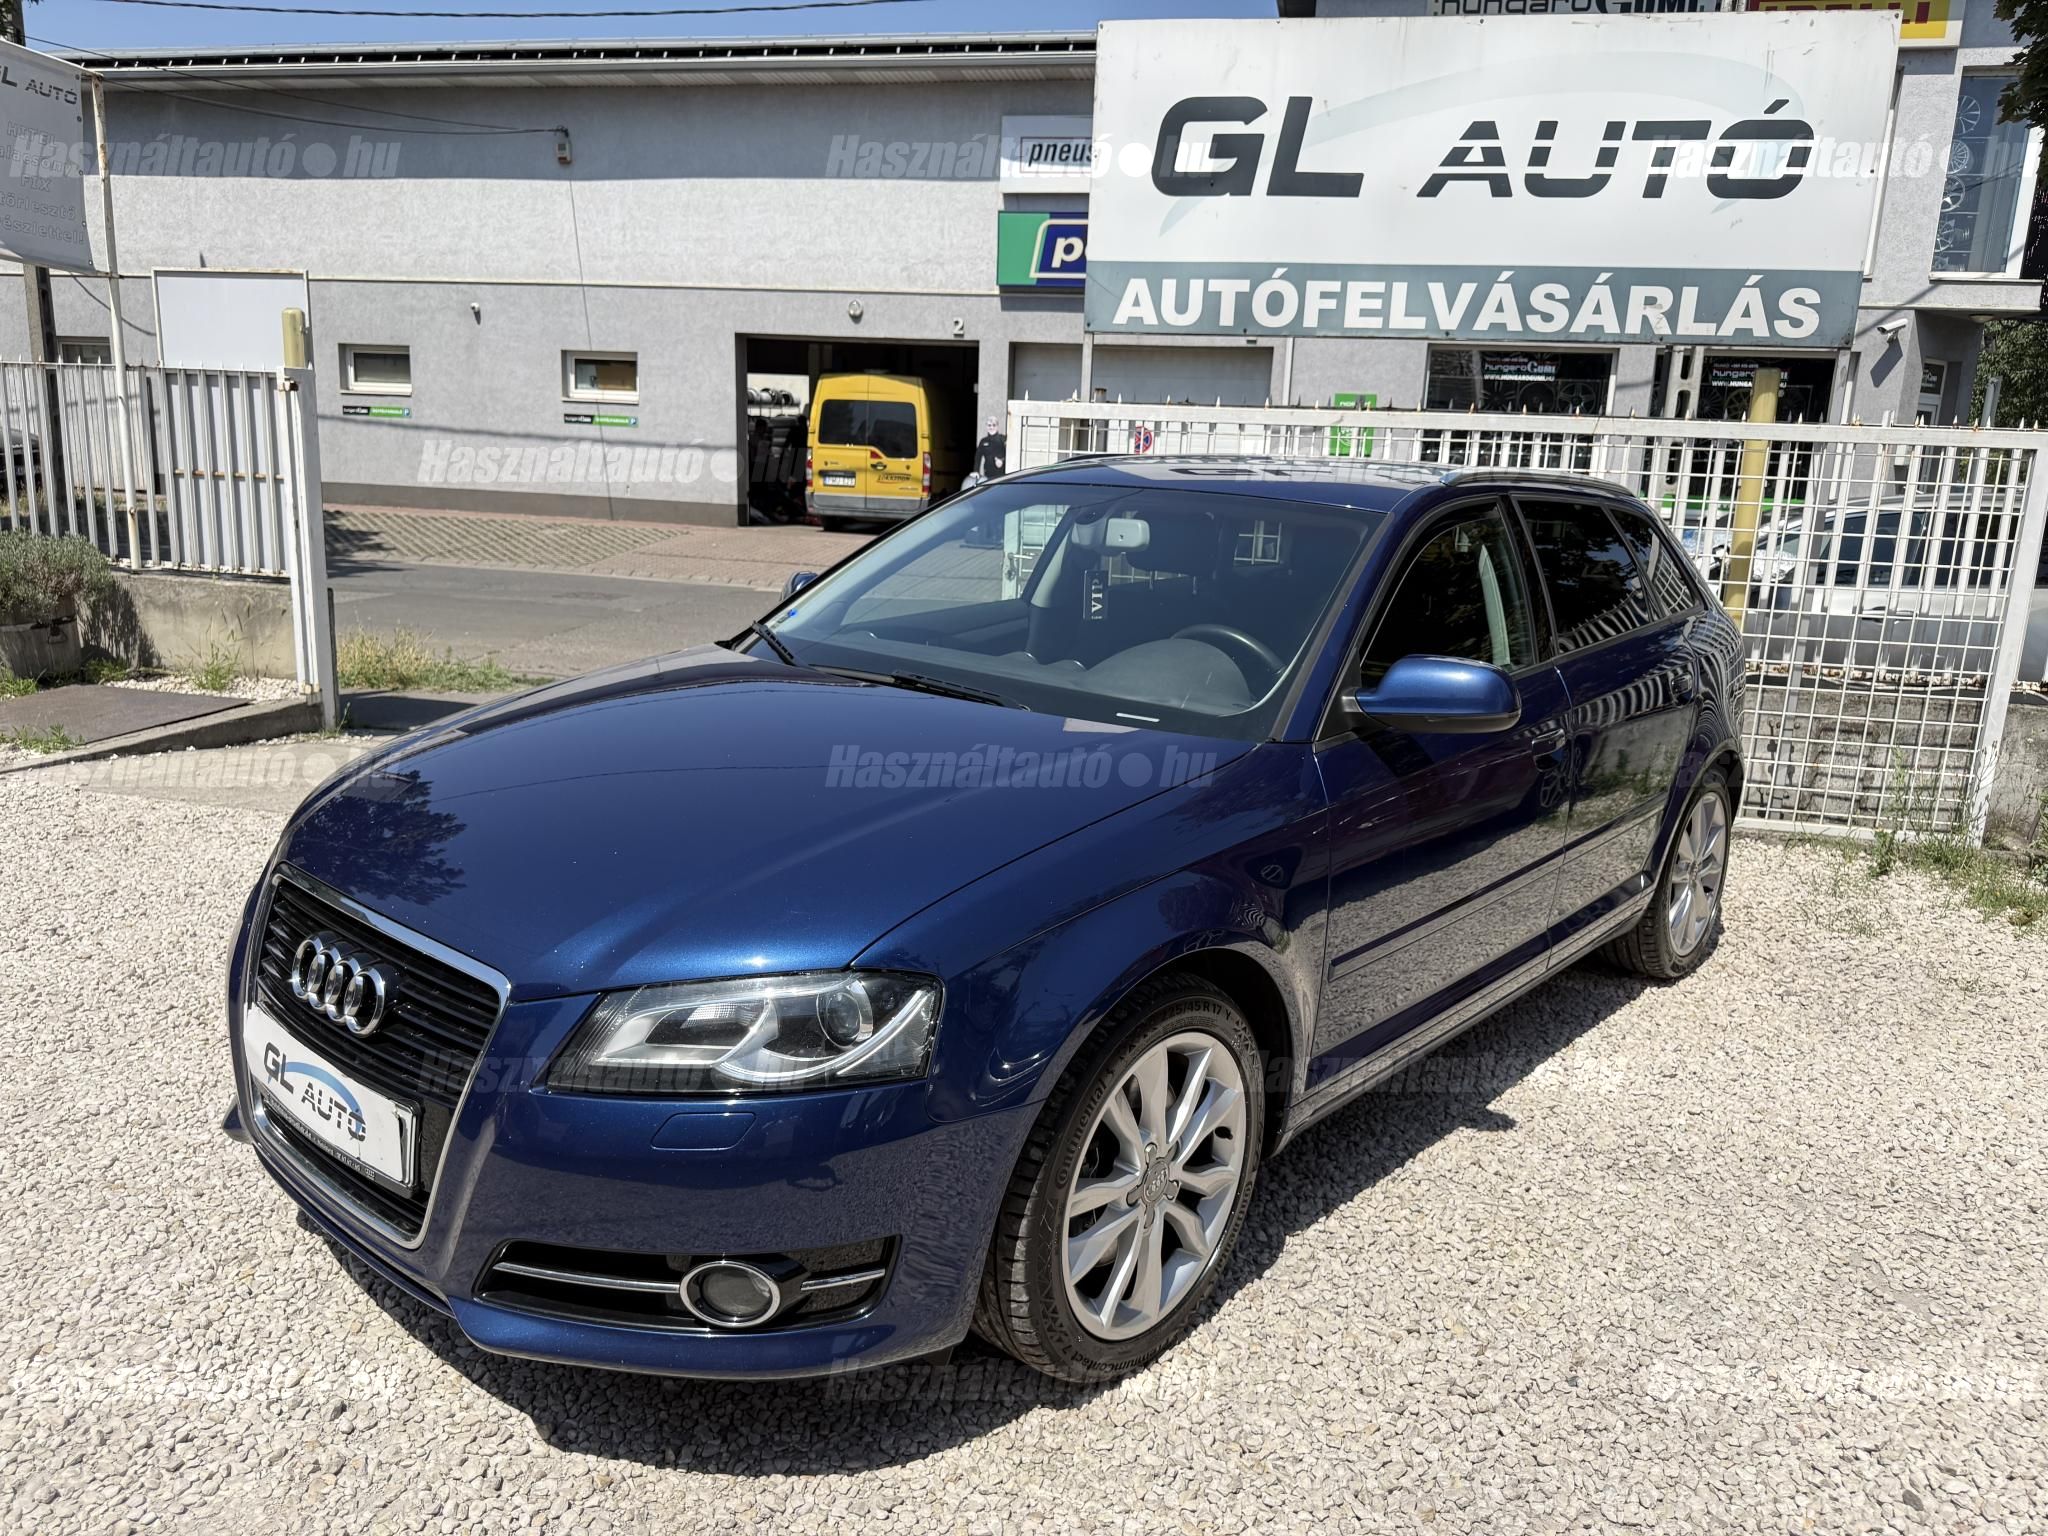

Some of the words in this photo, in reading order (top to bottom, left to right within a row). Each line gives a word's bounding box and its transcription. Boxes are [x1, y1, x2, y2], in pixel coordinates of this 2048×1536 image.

[7, 120, 57, 148] HITEL
[1151, 96, 1364, 197] GL
[1416, 99, 1815, 199] AUTÓ
[0, 214, 84, 245] észlettel!
[1113, 268, 1821, 339] AUTÓFELVÁSÁRLÁS
[953, 317, 965, 336] 2
[263, 1041, 295, 1095] GL
